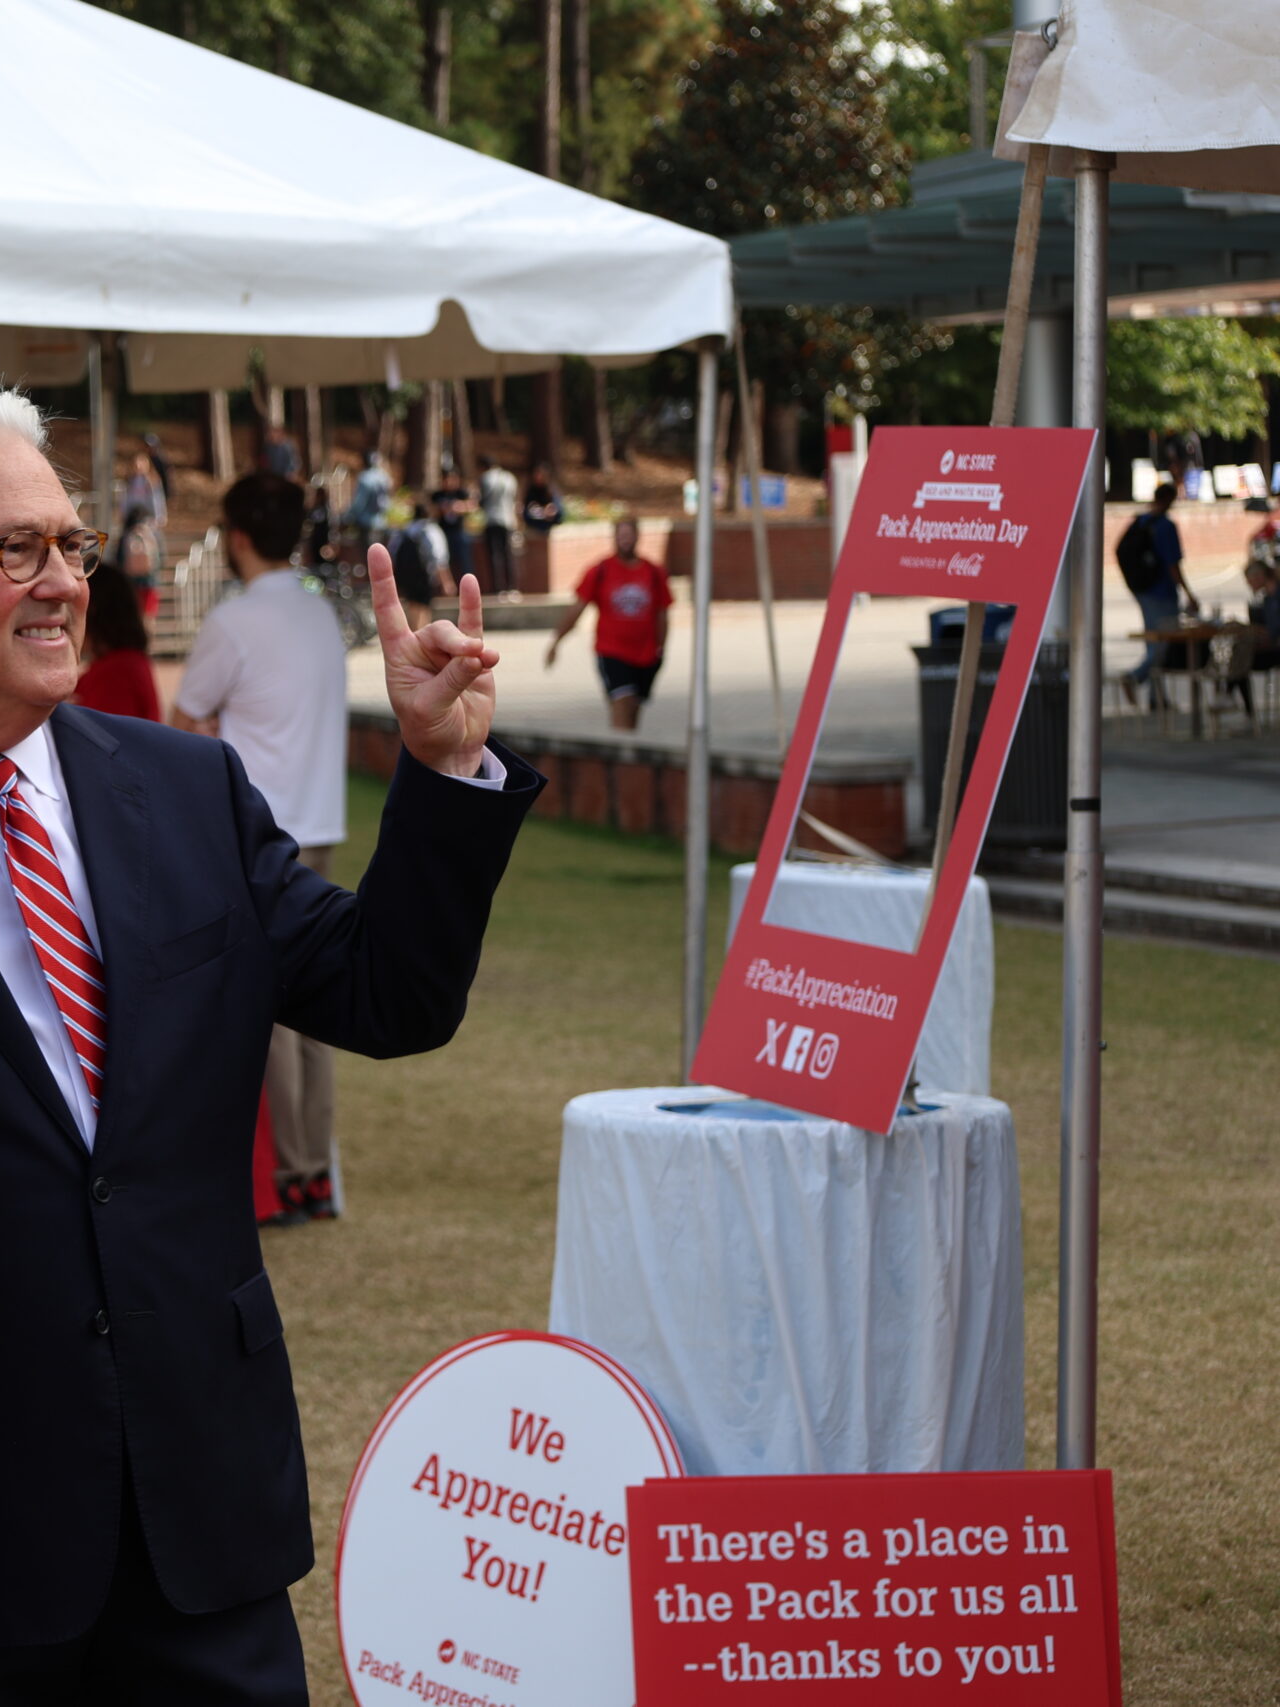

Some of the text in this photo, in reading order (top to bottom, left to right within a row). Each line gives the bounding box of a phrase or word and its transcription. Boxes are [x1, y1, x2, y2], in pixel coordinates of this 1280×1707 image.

[955, 454, 997, 472] NC STATE
[876, 514, 1029, 549] Pack Appreciation Day
[745, 958, 898, 1020] #PackAppreciation
[508, 1407, 565, 1463] We
[412, 1453, 626, 1556] Appreciate
[657, 1515, 1069, 1565] There's a place in
[462, 1536, 546, 1602] You!
[654, 1575, 1078, 1623] the Pack for us all
[357, 1650, 406, 1687] Pack
[461, 1650, 521, 1685] NC STATE
[683, 1635, 1056, 1684] --thanks to you!
